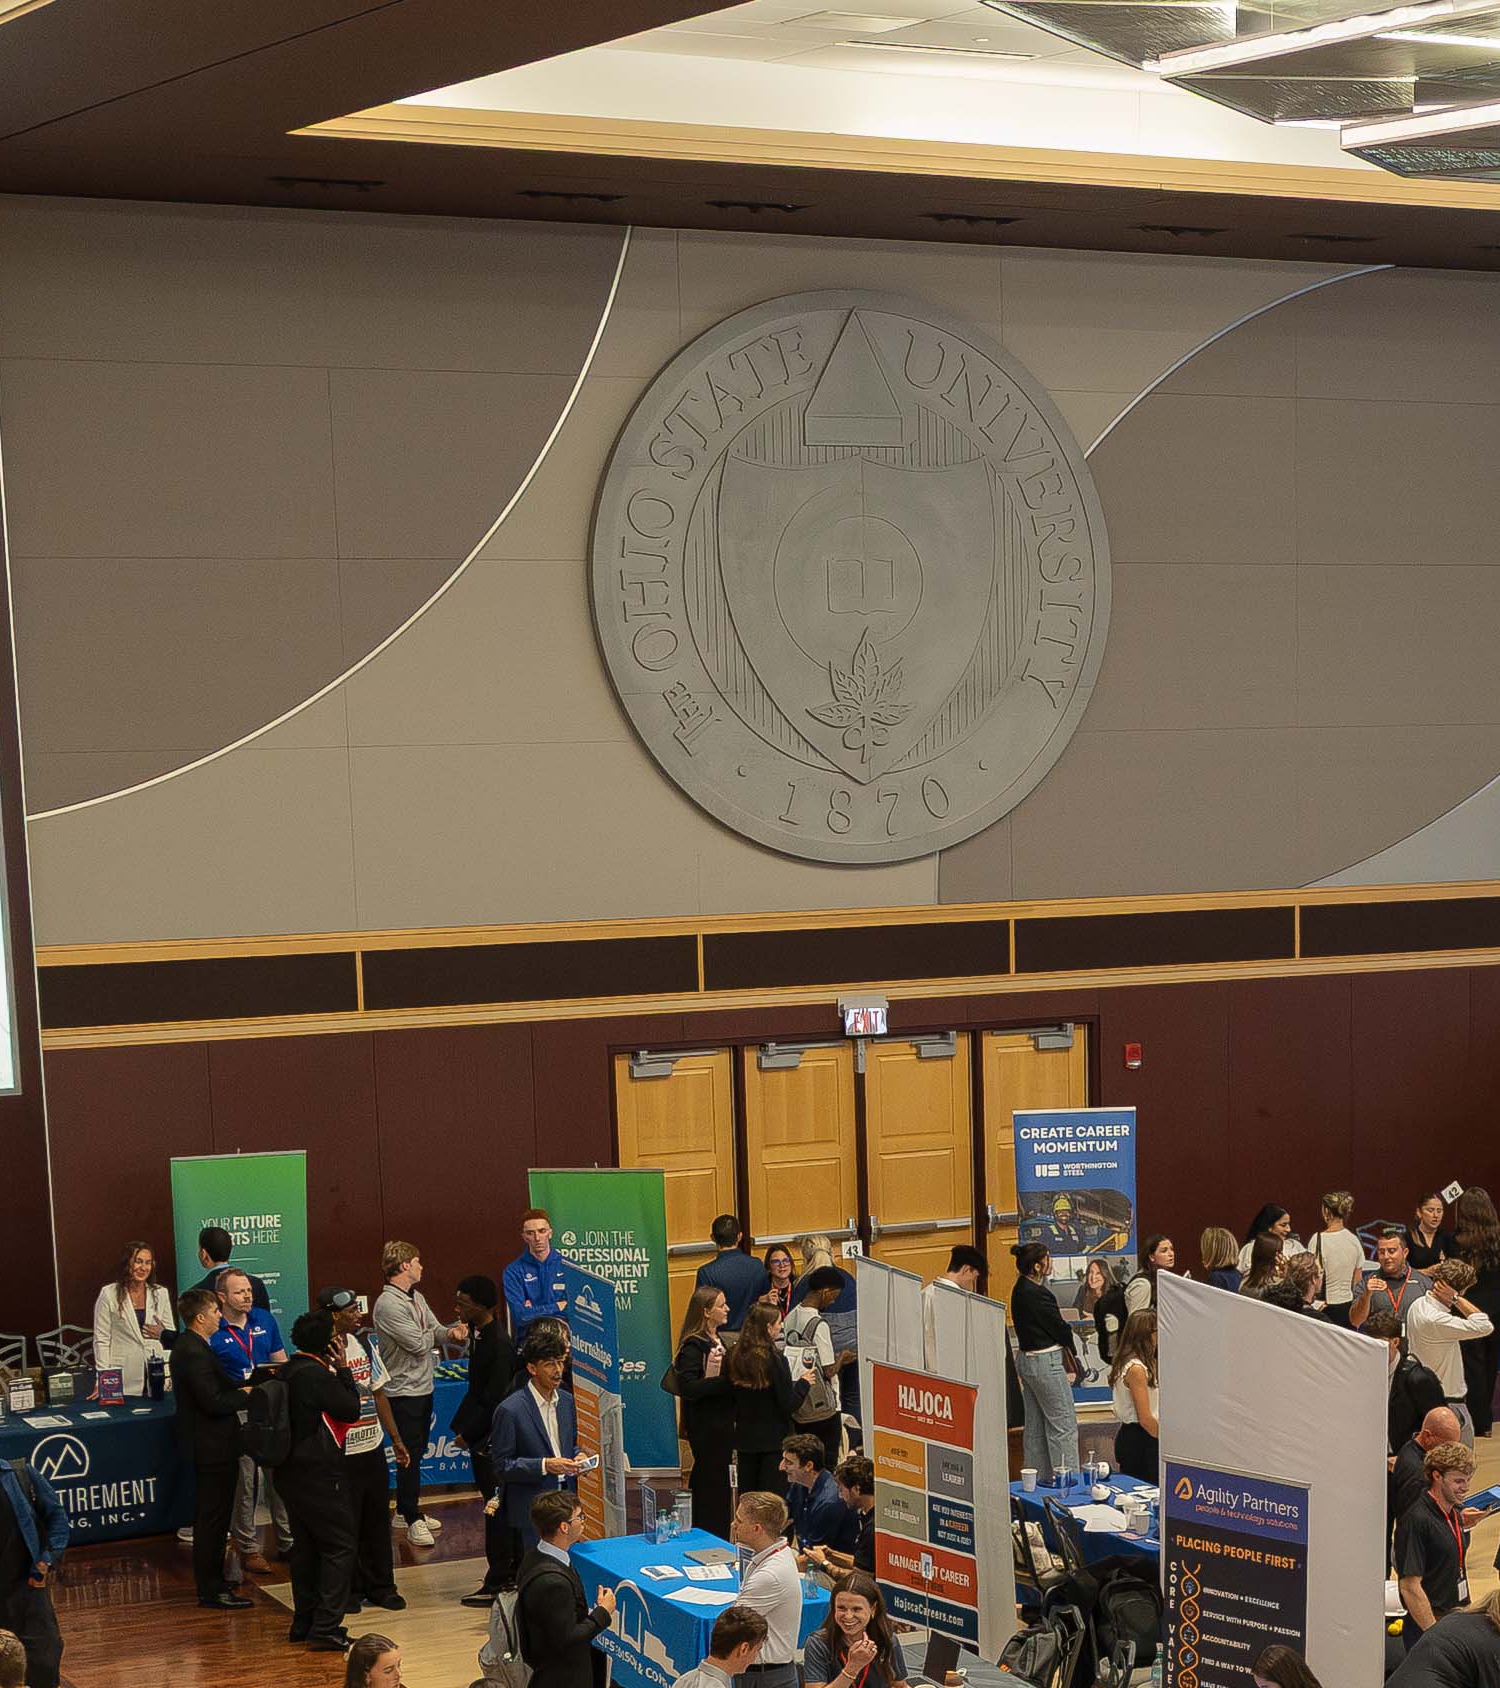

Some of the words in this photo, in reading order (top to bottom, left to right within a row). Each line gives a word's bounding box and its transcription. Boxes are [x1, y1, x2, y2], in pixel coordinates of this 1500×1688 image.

[649, 323, 819, 480] STATE
[902, 329, 1086, 710] UNIVERSITY
[617, 489, 682, 673] OHIO
[778, 776, 951, 837] 1870
[1020, 1126, 1073, 1139] CREATE
[1076, 1125, 1130, 1137] CAREER
[1033, 1140, 1118, 1154] MOMENTUM
[1063, 1162, 1118, 1170] WORTHINGTON
[1446, 1187, 1460, 1198] 42
[233, 1214, 282, 1228] FUTURE
[252, 1230, 280, 1244] HERE
[581, 1231, 609, 1246] JOIN
[612, 1230, 635, 1246] THE
[898, 1384, 953, 1421] HAJOCA
[1196, 1484, 1239, 1509] Agility
[1243, 1493, 1299, 1519] Partners
[101, 1511, 135, 1526] INC.
[1195, 1504, 1219, 1517] people
[1266, 1518, 1298, 1531] solutions
[1176, 1535, 1220, 1554] PLACING
[1223, 1545, 1262, 1563] PEOPLE
[1264, 1553, 1296, 1569] FIRST
[940, 1568, 970, 1588] CAREER
[1169, 1561, 1178, 1609] CORE
[1203, 1587, 1239, 1601] INNOVATION
[1244, 1596, 1280, 1610] EXCELLENCE
[894, 1595, 965, 1628] HajocaCareers.com
[1203, 1610, 1225, 1623] SERVICE
[1226, 1616, 1241, 1626] WITH
[1242, 1618, 1268, 1631] PURPOSE
[1274, 1625, 1300, 1638] PASSION
[1202, 1633, 1251, 1651] ACCOUNTABILITY
